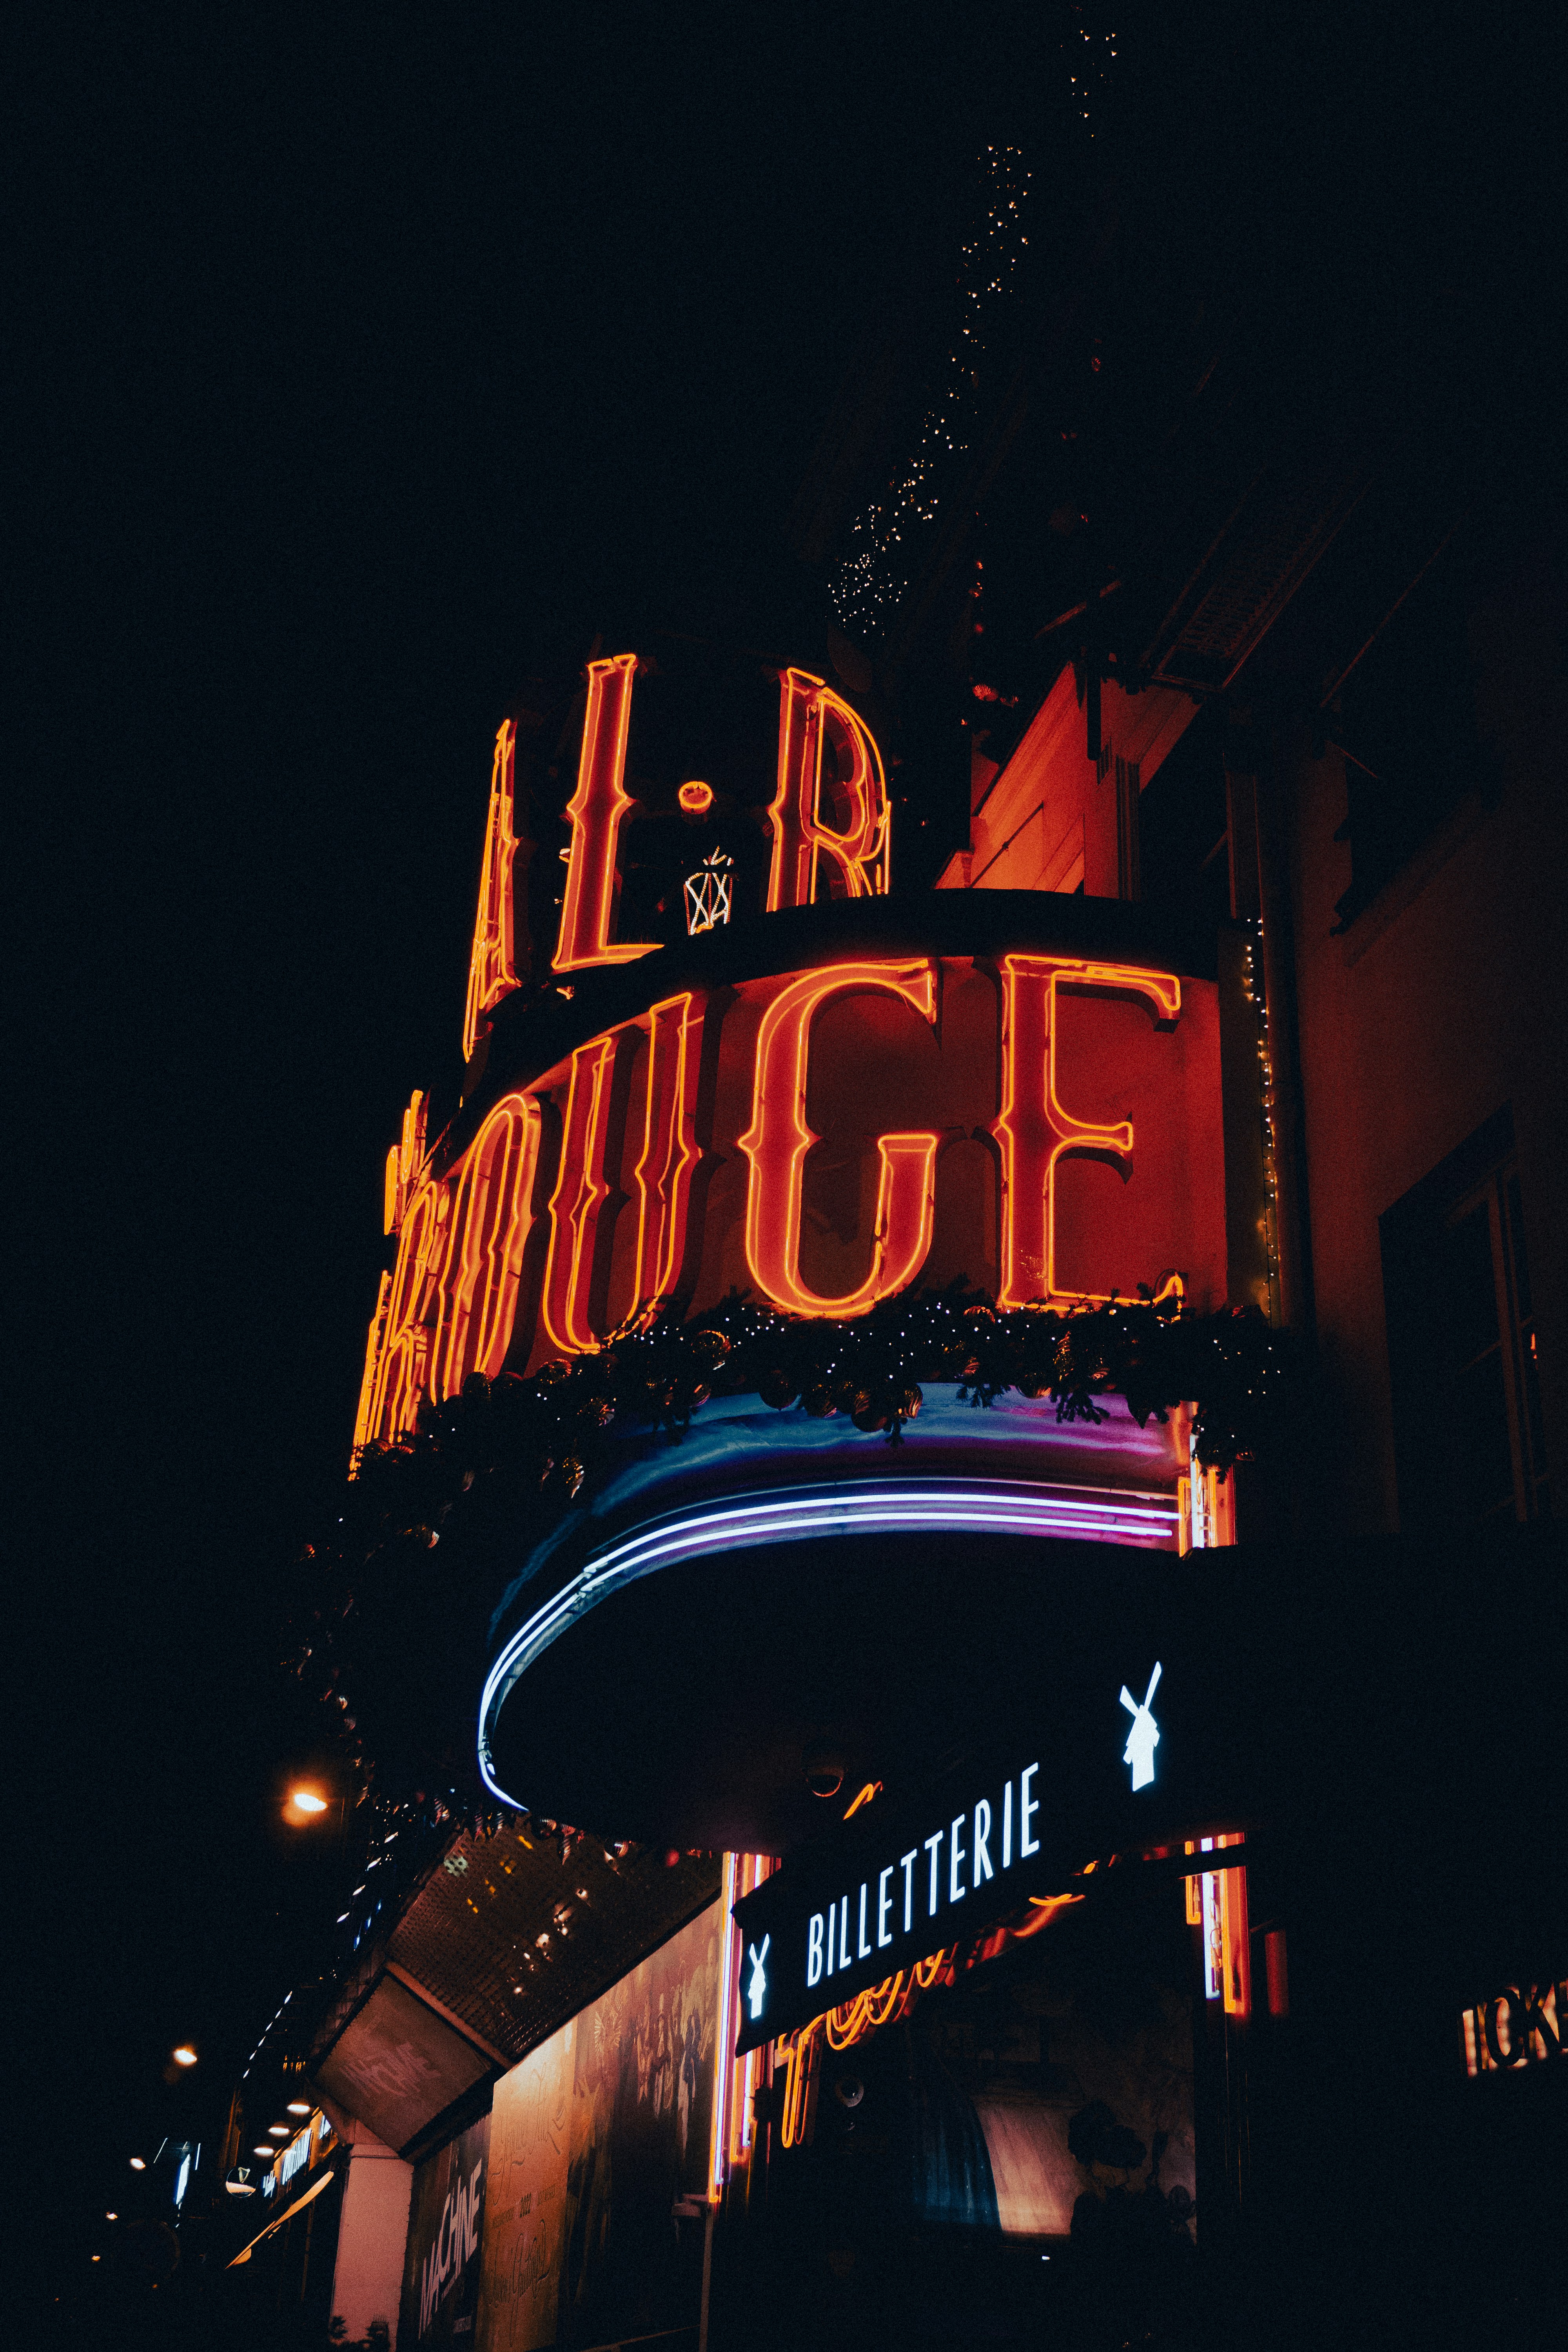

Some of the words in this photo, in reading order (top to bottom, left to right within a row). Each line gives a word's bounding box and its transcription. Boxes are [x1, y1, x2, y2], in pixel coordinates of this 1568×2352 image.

[374, 953, 1186, 1446] ROUGE
[807, 1762, 1040, 1987] BILLETTERIE
[418, 2158, 482, 2340] MACHINE
[519, 2192, 532, 2218] 2022
